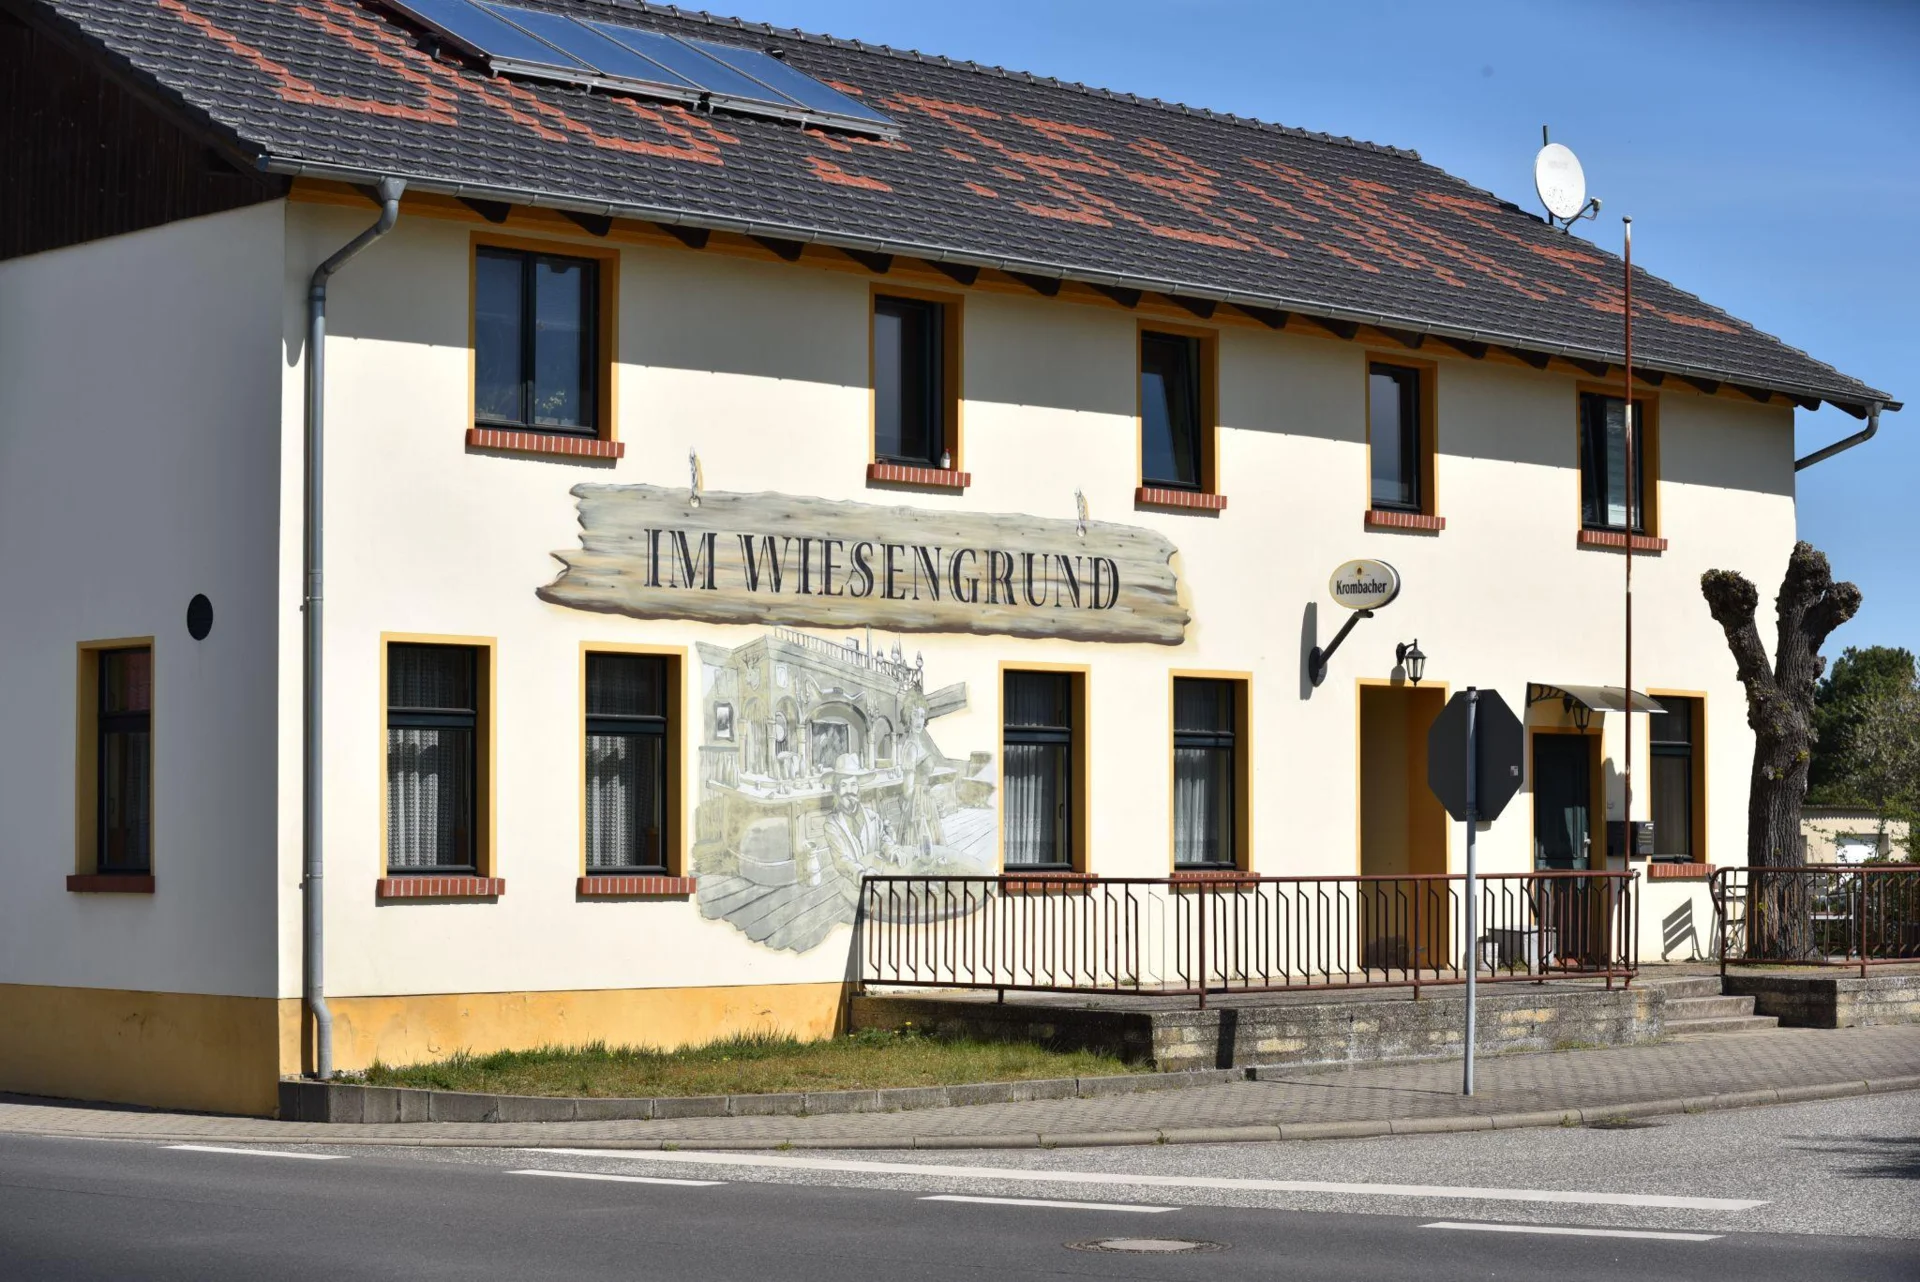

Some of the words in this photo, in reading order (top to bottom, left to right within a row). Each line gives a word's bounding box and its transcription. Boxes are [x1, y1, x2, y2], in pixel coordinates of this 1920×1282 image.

[643, 528, 718, 591] IM
[739, 533, 1121, 611] WIESENGRUND
[1336, 579, 1387, 595] Krombacher
